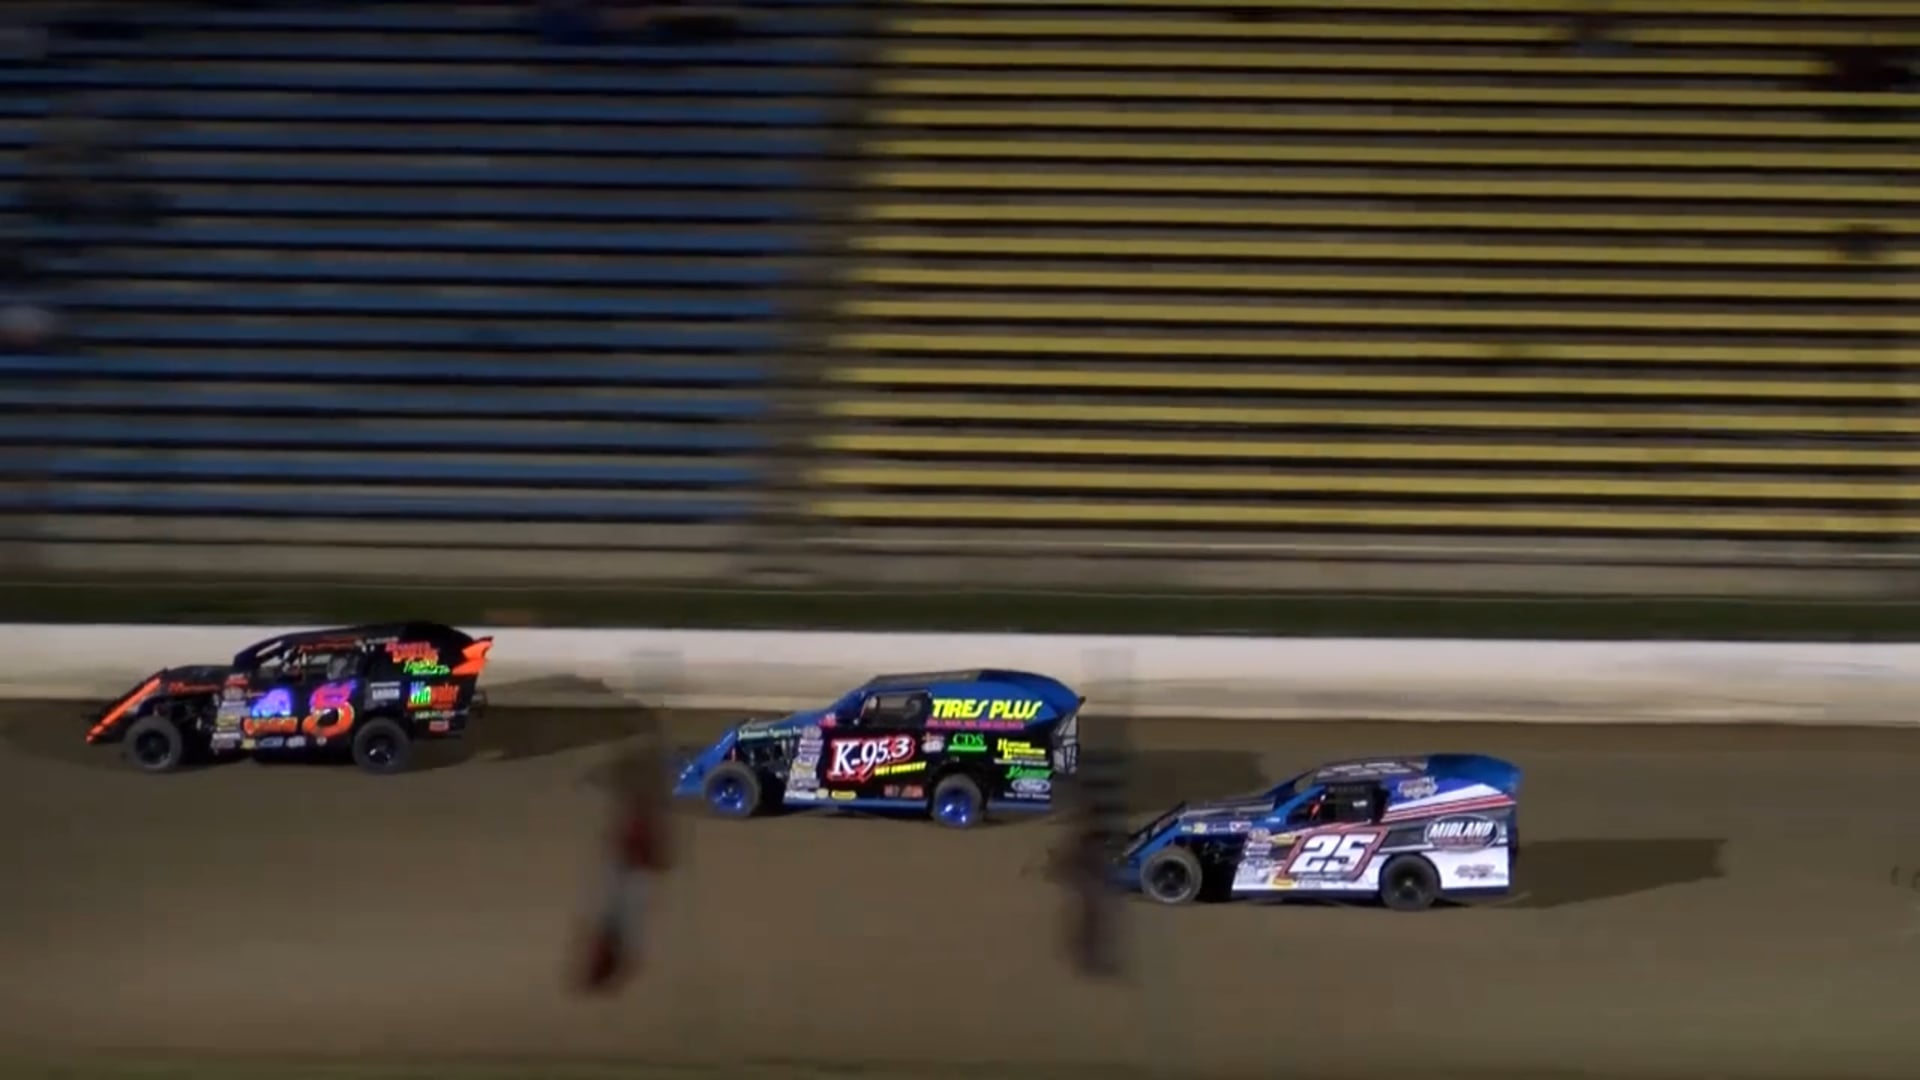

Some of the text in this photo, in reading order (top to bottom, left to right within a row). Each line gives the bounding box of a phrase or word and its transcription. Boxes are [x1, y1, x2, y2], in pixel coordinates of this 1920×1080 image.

[932, 698, 1043, 720] TIRES PLUS
[952, 733, 985, 746] CDS
[831, 736, 912, 777] K-95.3
[1428, 821, 1494, 838] MIDLAND
[1288, 833, 1378, 873] 25
